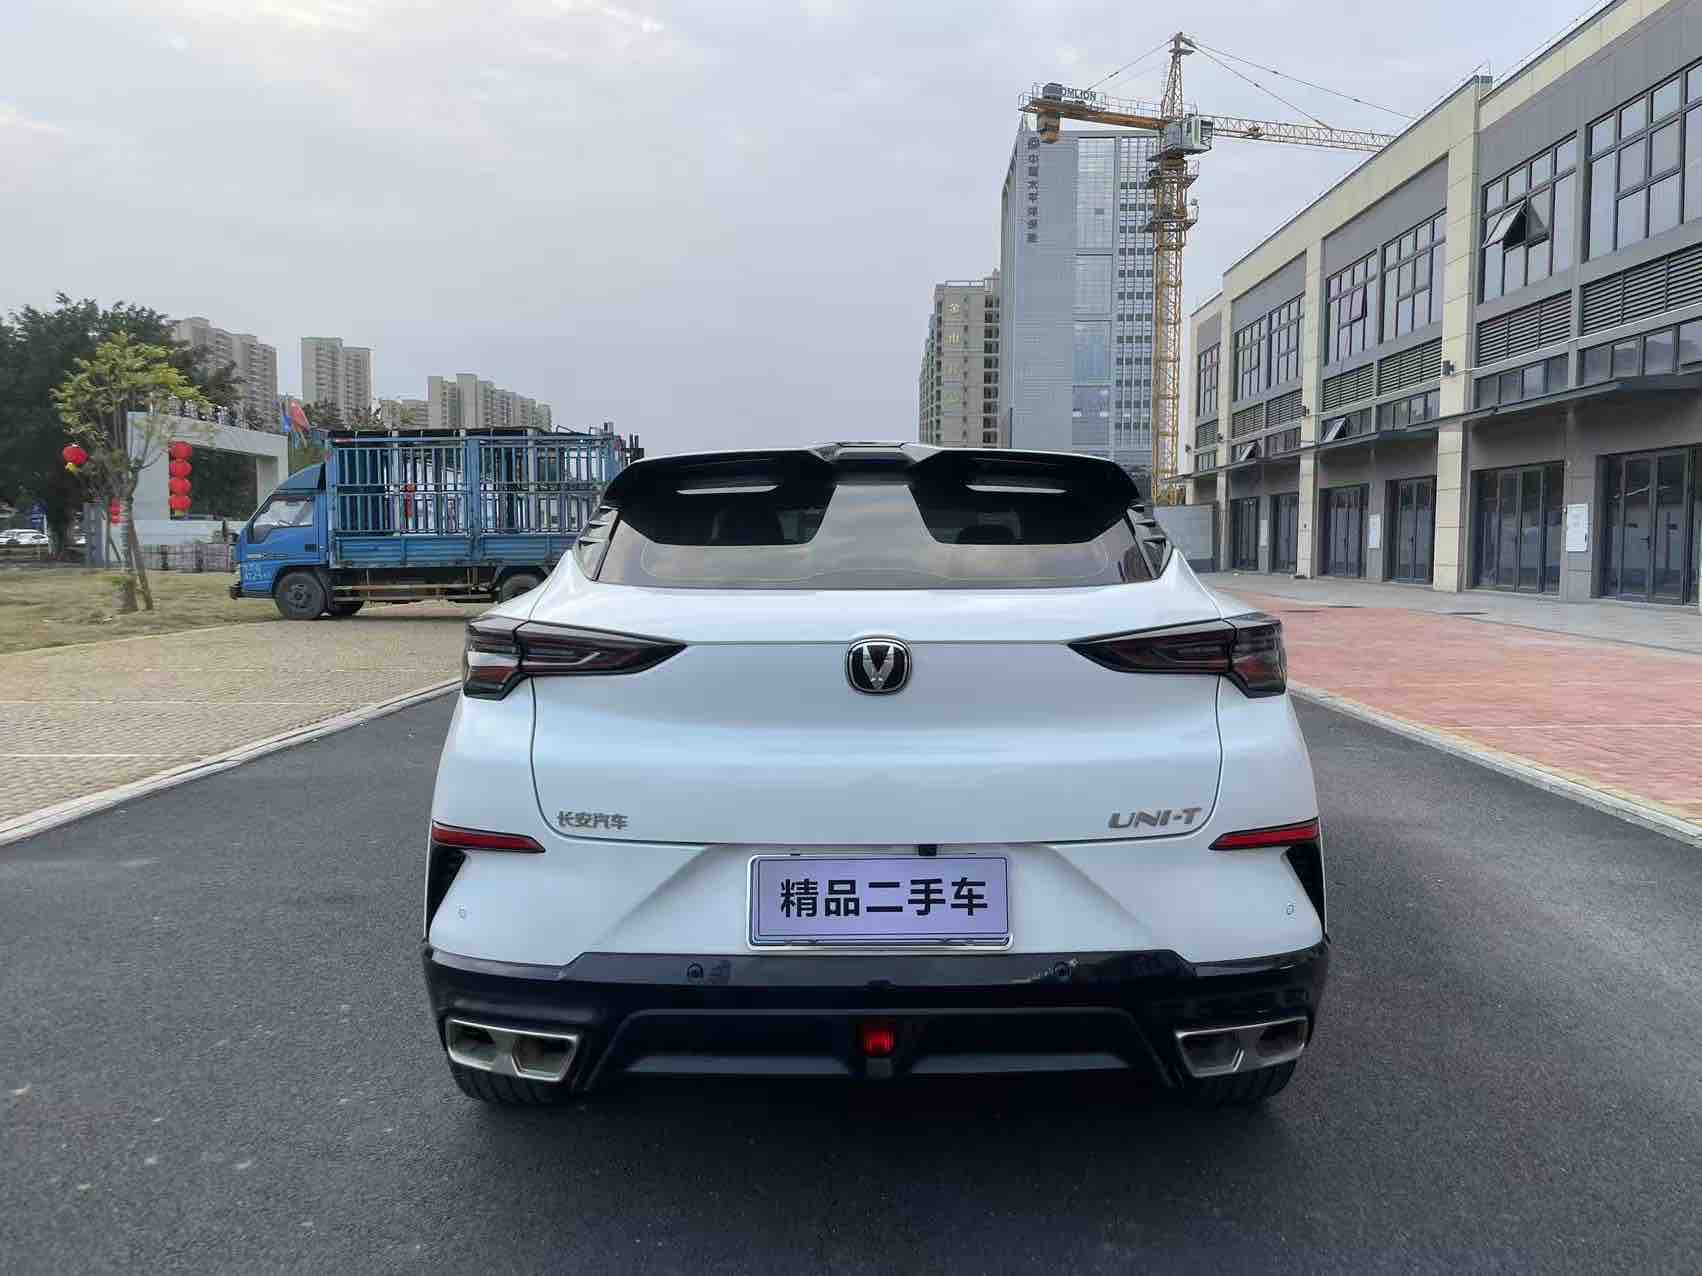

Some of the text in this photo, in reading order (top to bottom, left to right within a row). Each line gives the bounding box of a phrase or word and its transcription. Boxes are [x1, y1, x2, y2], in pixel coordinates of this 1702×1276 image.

[558, 811, 628, 830] 长安汽车
[1108, 807, 1202, 829] UNI-T
[780, 877, 988, 918] 精品二手车
